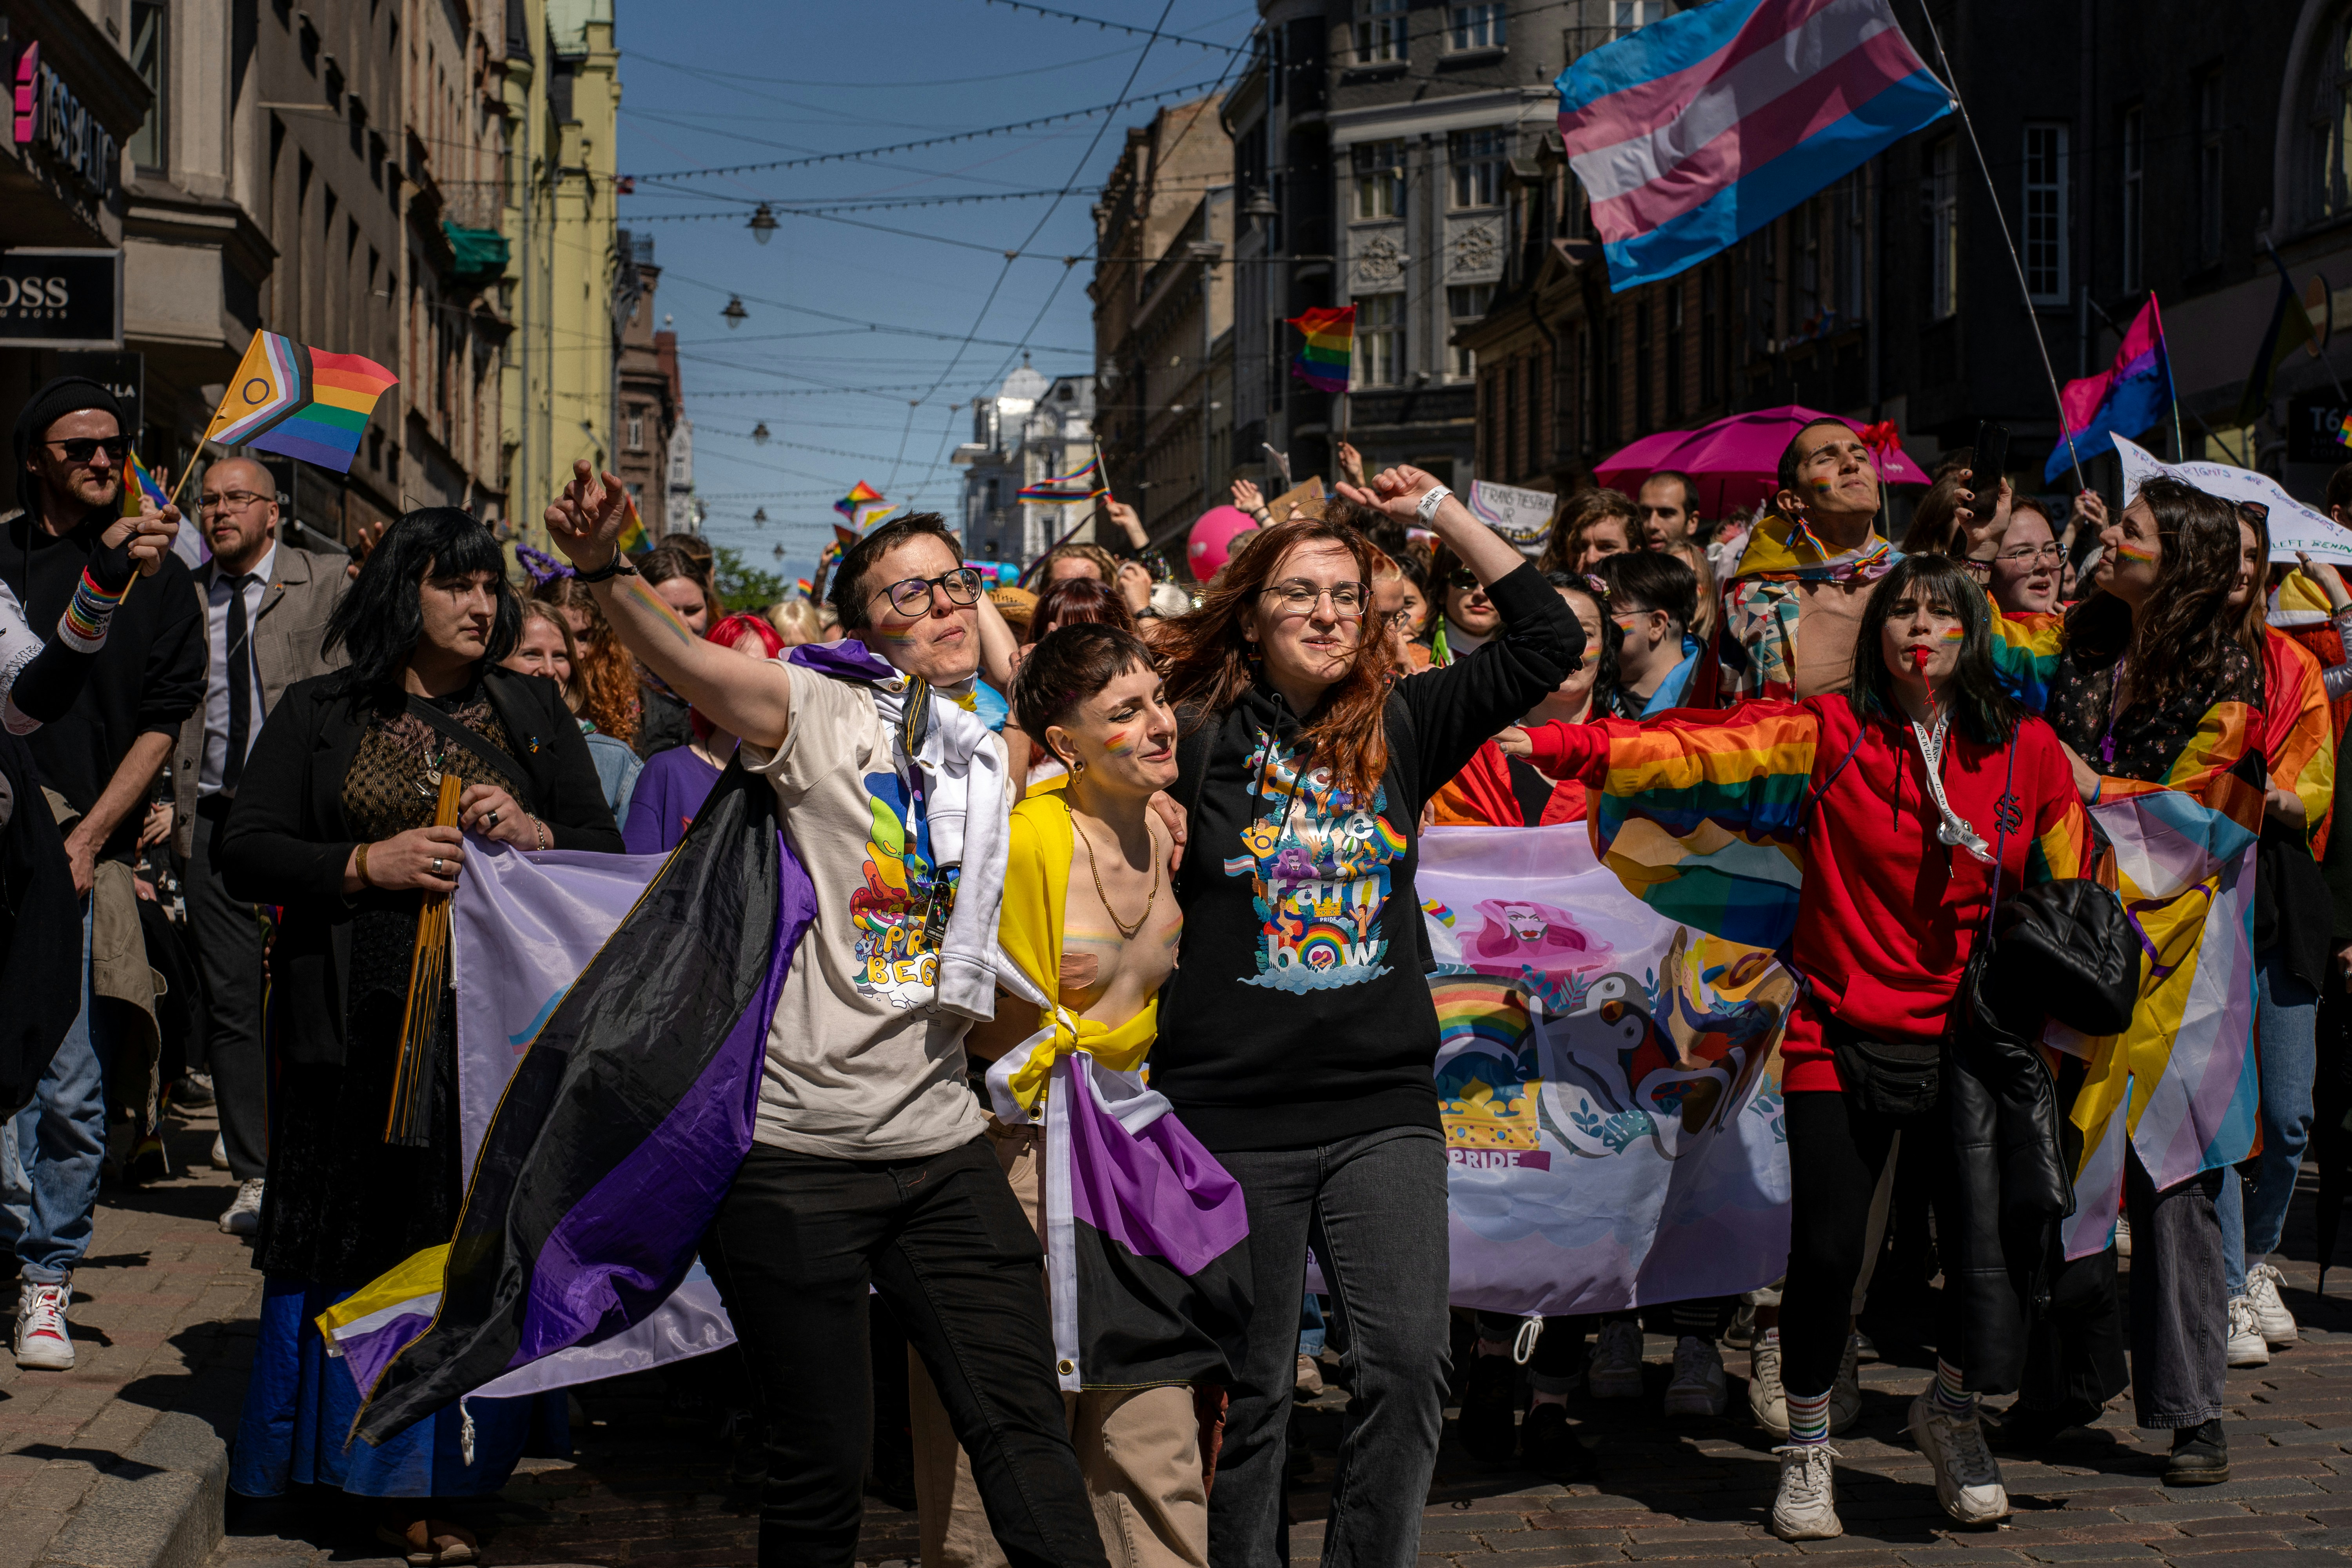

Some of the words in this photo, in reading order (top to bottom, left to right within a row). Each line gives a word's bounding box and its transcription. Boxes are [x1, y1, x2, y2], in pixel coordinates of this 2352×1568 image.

[20, 308, 67, 319] BOSS
[2181, 466, 2231, 479] RIGHTS
[1481, 485, 1514, 506] TRANS
[2272, 539, 2303, 549] LEFT
[1267, 867, 1380, 915] rain
[1268, 934, 1379, 974] bow
[1448, 1149, 1521, 1169] PRIDE
